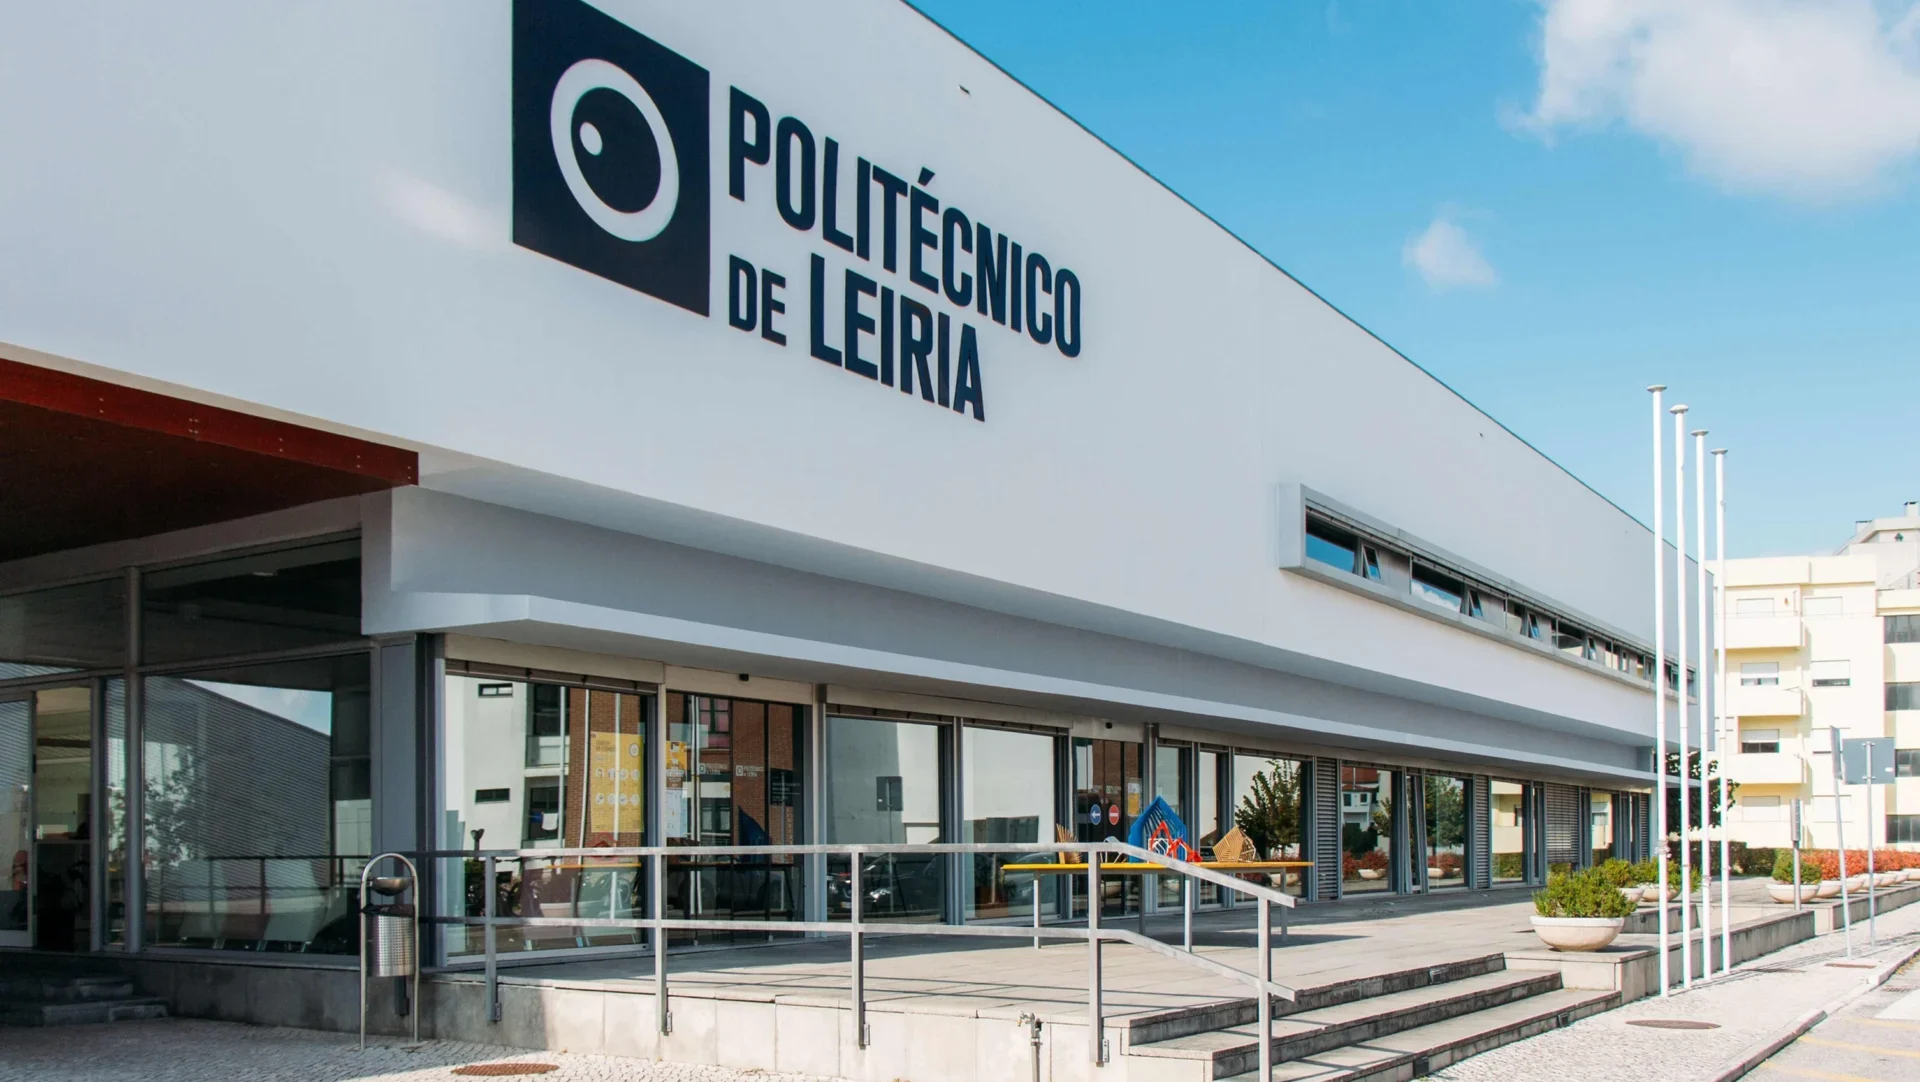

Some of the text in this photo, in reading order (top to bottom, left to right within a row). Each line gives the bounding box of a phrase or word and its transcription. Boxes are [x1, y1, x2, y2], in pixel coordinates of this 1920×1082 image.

[729, 86, 1081, 358] POLITÉCNICO
[729, 253, 986, 422] DE LEIRIA
